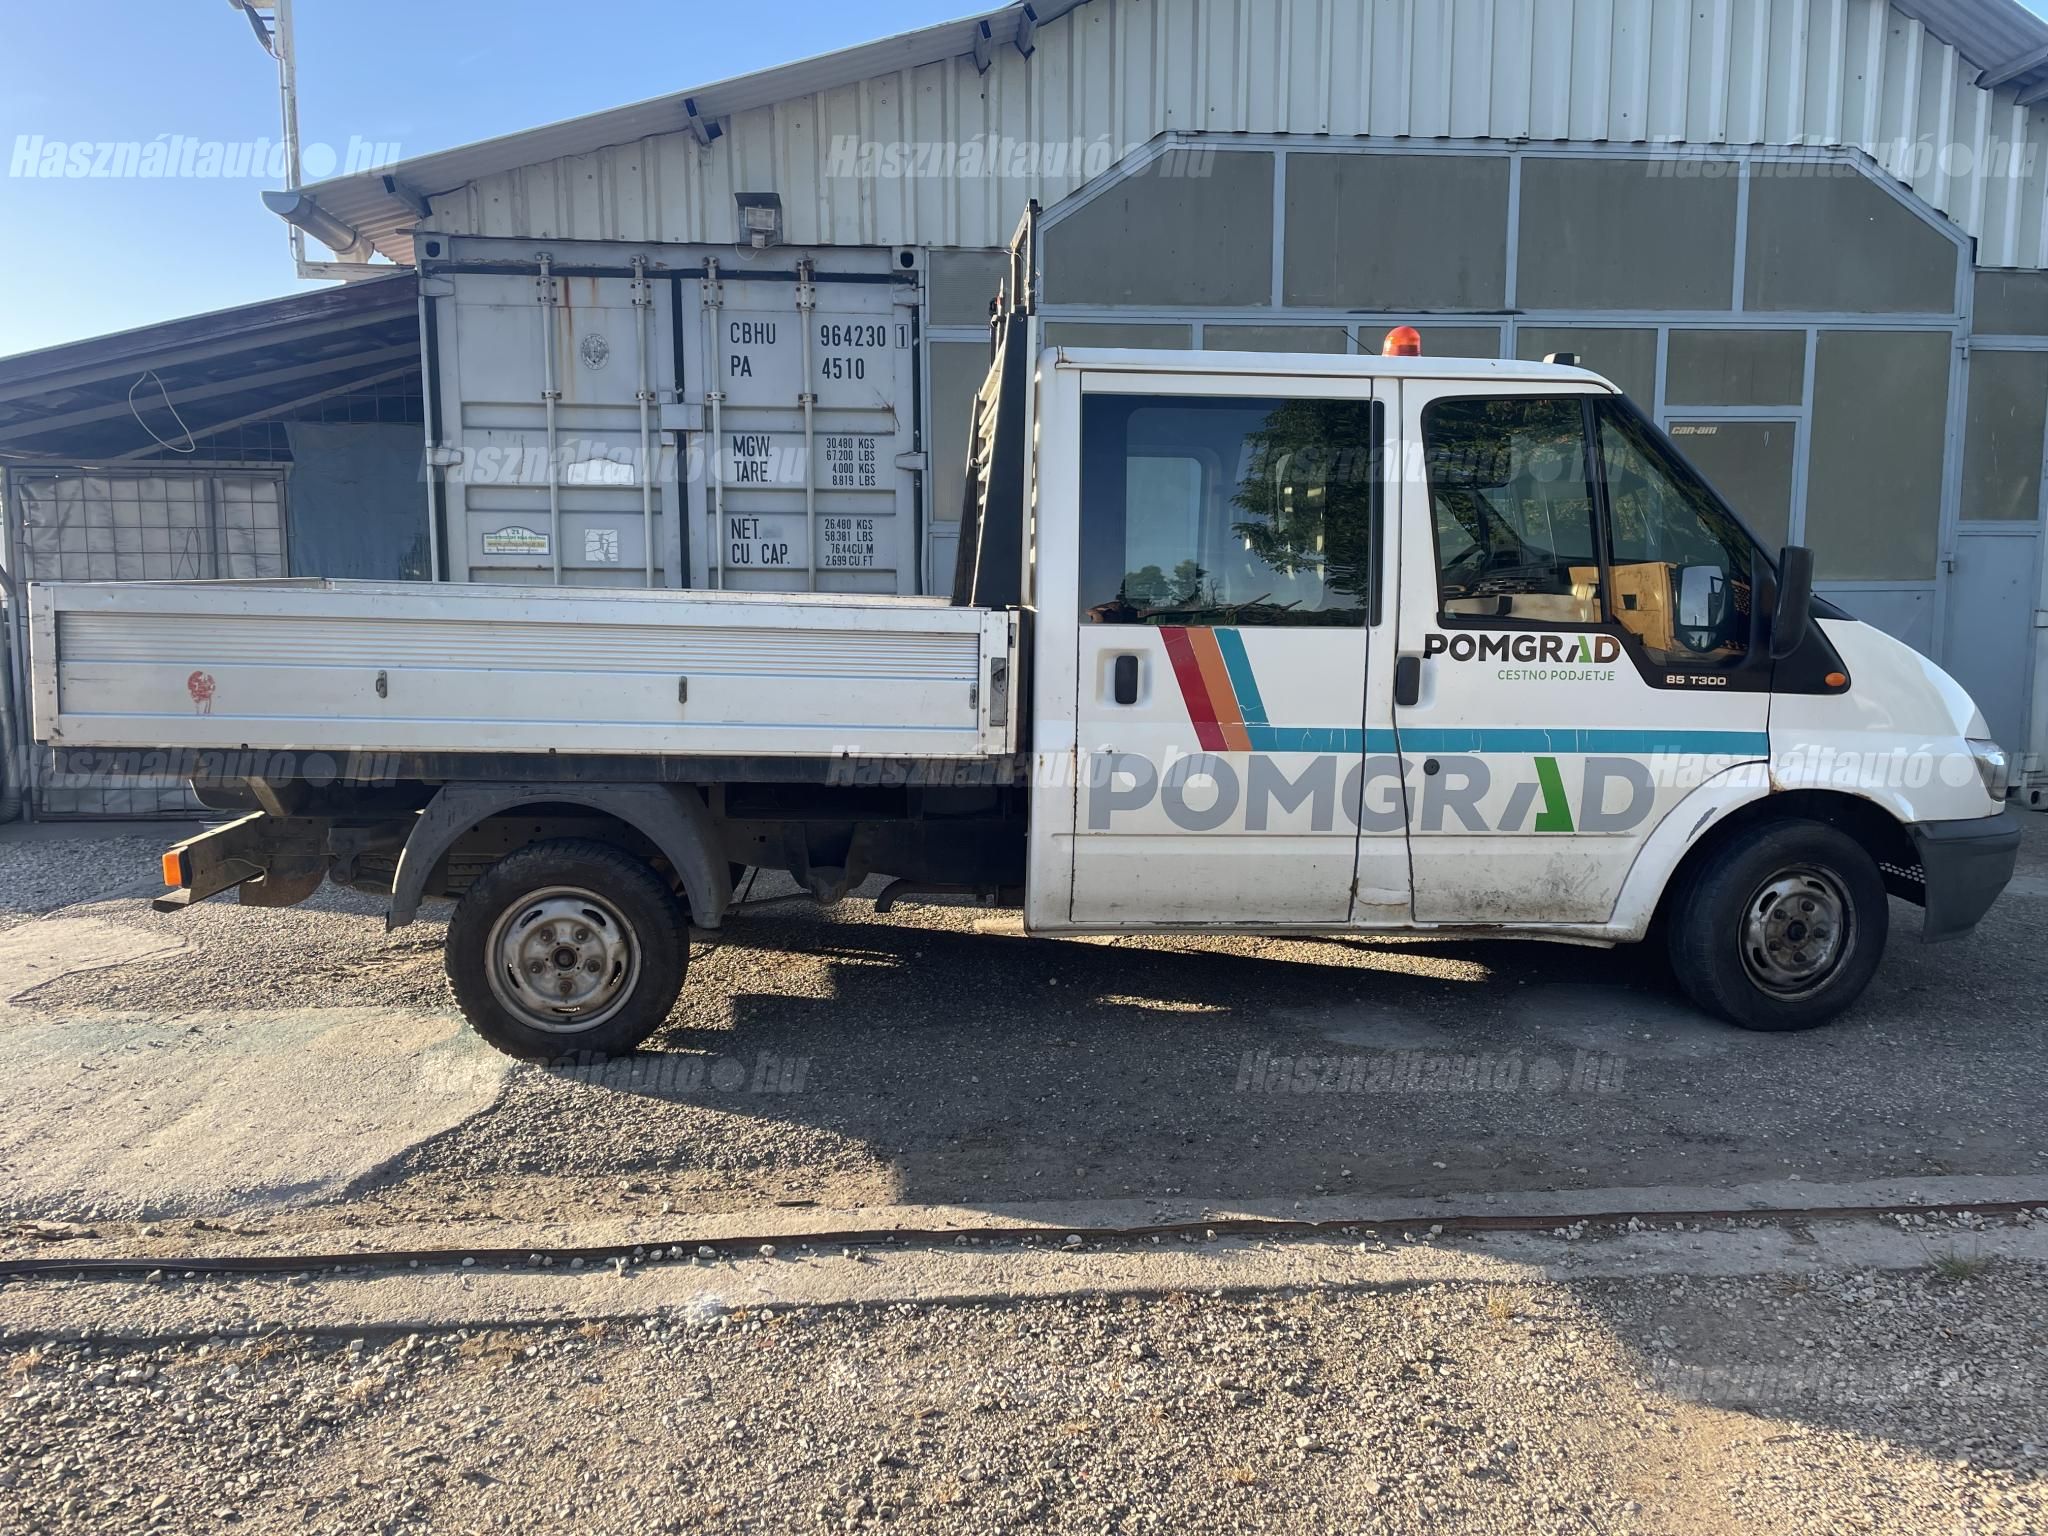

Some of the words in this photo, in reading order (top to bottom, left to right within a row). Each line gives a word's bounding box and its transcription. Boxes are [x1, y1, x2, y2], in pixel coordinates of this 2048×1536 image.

[730, 322, 776, 345] CBHU
[820, 324, 886, 348] 964230
[730, 355, 752, 378] PA
[822, 357, 865, 380] 4510
[733, 435, 772, 457] MGW.
[858, 438, 875, 449] KGS
[858, 450, 876, 461] LBS
[734, 460, 772, 482] TARE.
[858, 463, 876, 474] KGS
[859, 475, 876, 487] LBS
[731, 518, 762, 540] NET.
[824, 518, 852, 530] 26.480
[856, 519, 873, 530] KGS
[856, 531, 874, 542] LBS
[732, 543, 753, 564] CU.
[761, 543, 790, 565] CAP.
[1424, 633, 1621, 664] POMGRAD
[1497, 669, 1547, 681] CESTNO
[1550, 670, 1615, 682] PODJETJE
[1666, 675, 1684, 685] 85
[1690, 675, 1726, 685] T300
[1087, 753, 1656, 835] POMGRAD
